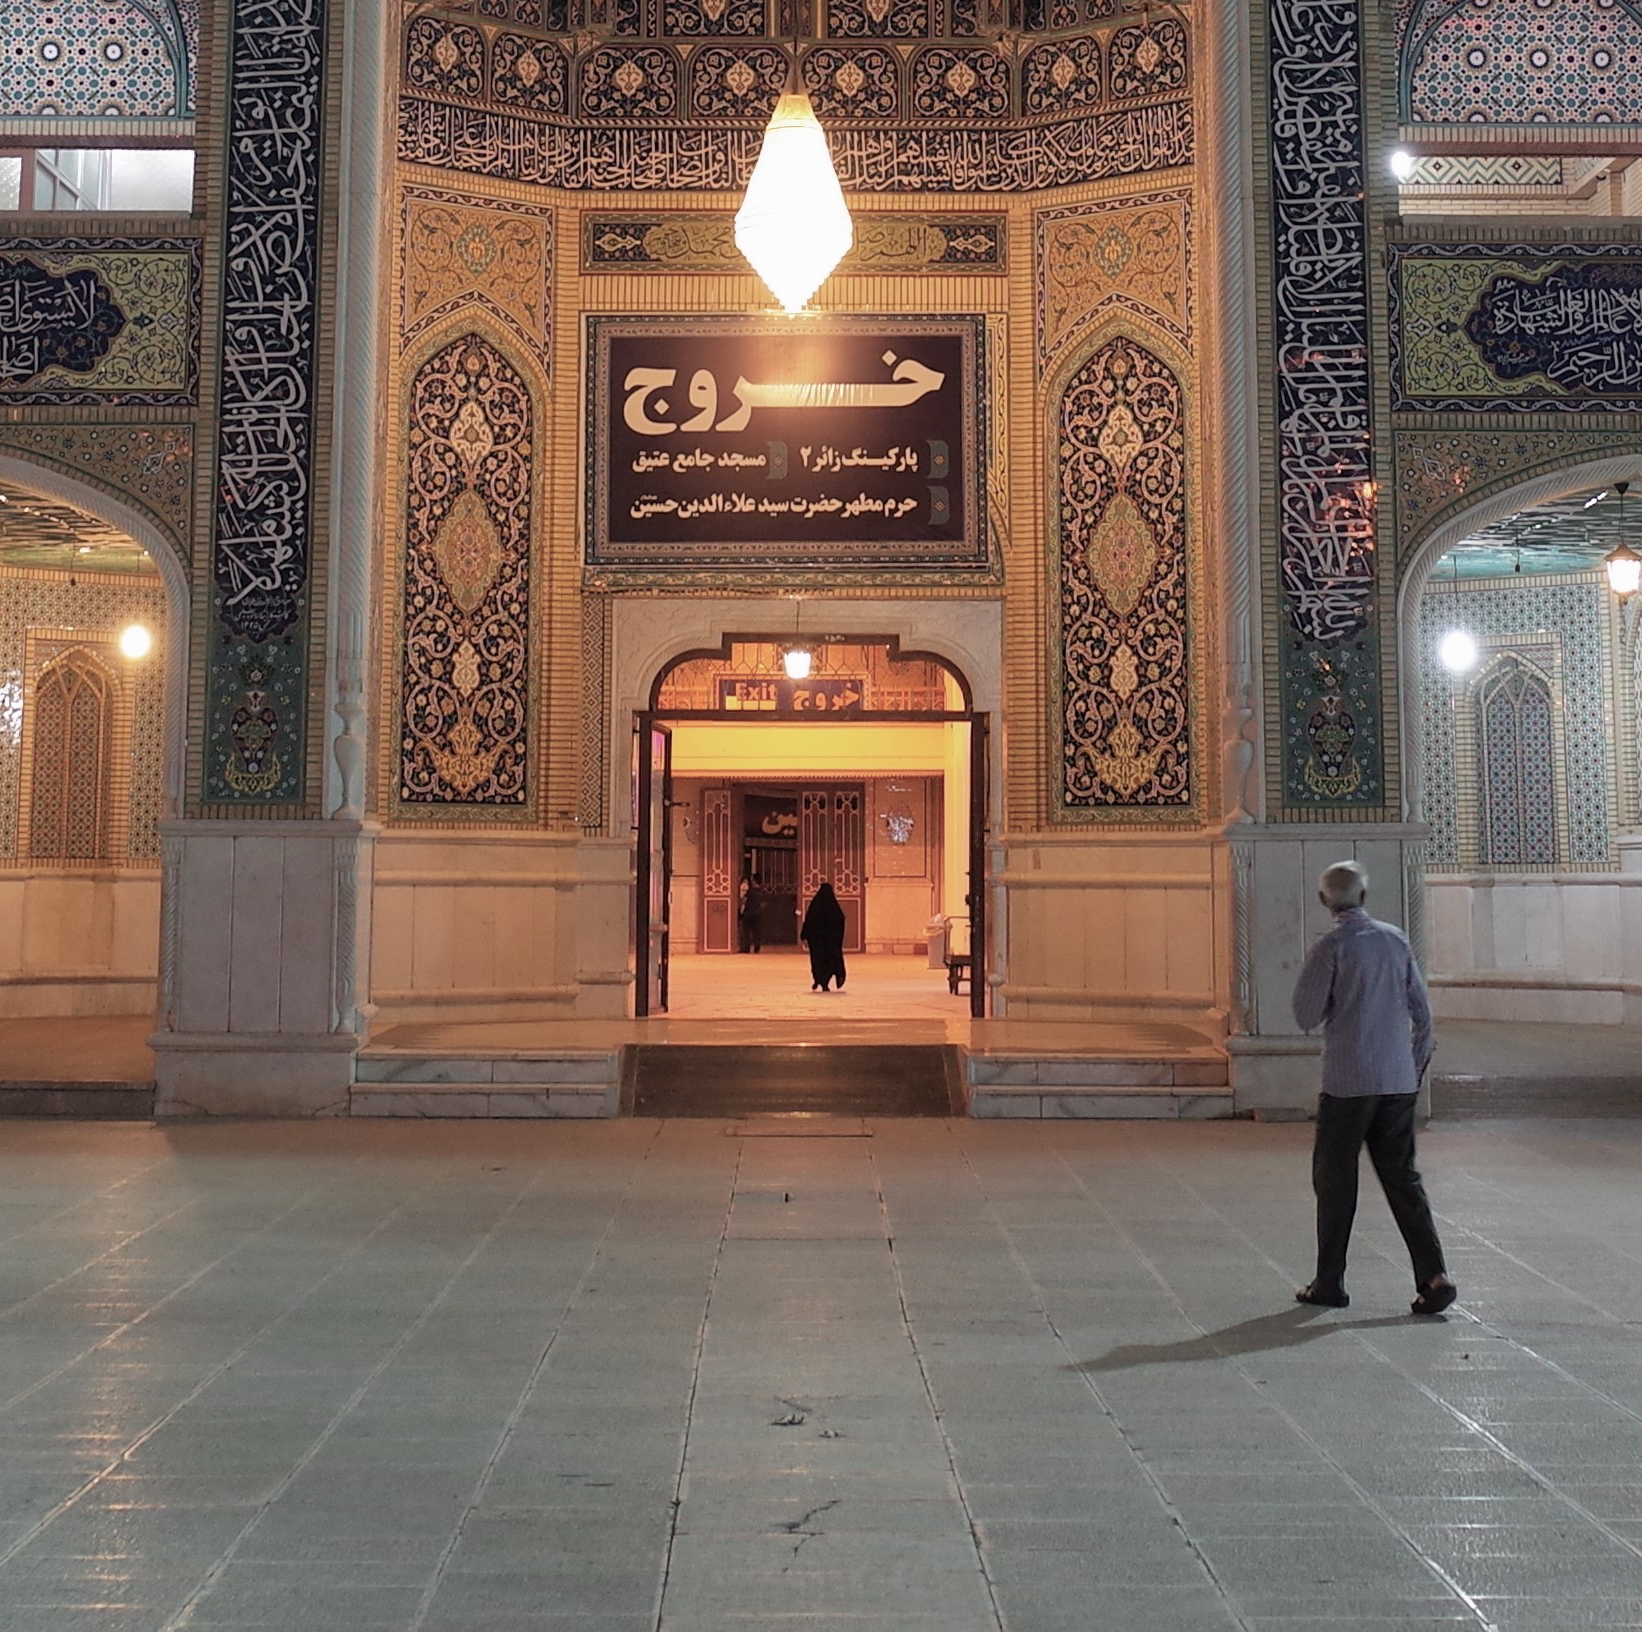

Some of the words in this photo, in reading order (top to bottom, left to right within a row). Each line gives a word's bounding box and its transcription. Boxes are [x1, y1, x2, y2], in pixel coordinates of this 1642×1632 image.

[622, 349, 947, 436] خروج
[672, 447, 717, 473] جامع
[717, 449, 767, 472] مسجد
[841, 495, 884, 518] مطهر
[883, 497, 918, 519] حرم
[735, 682, 778, 701] Exit
